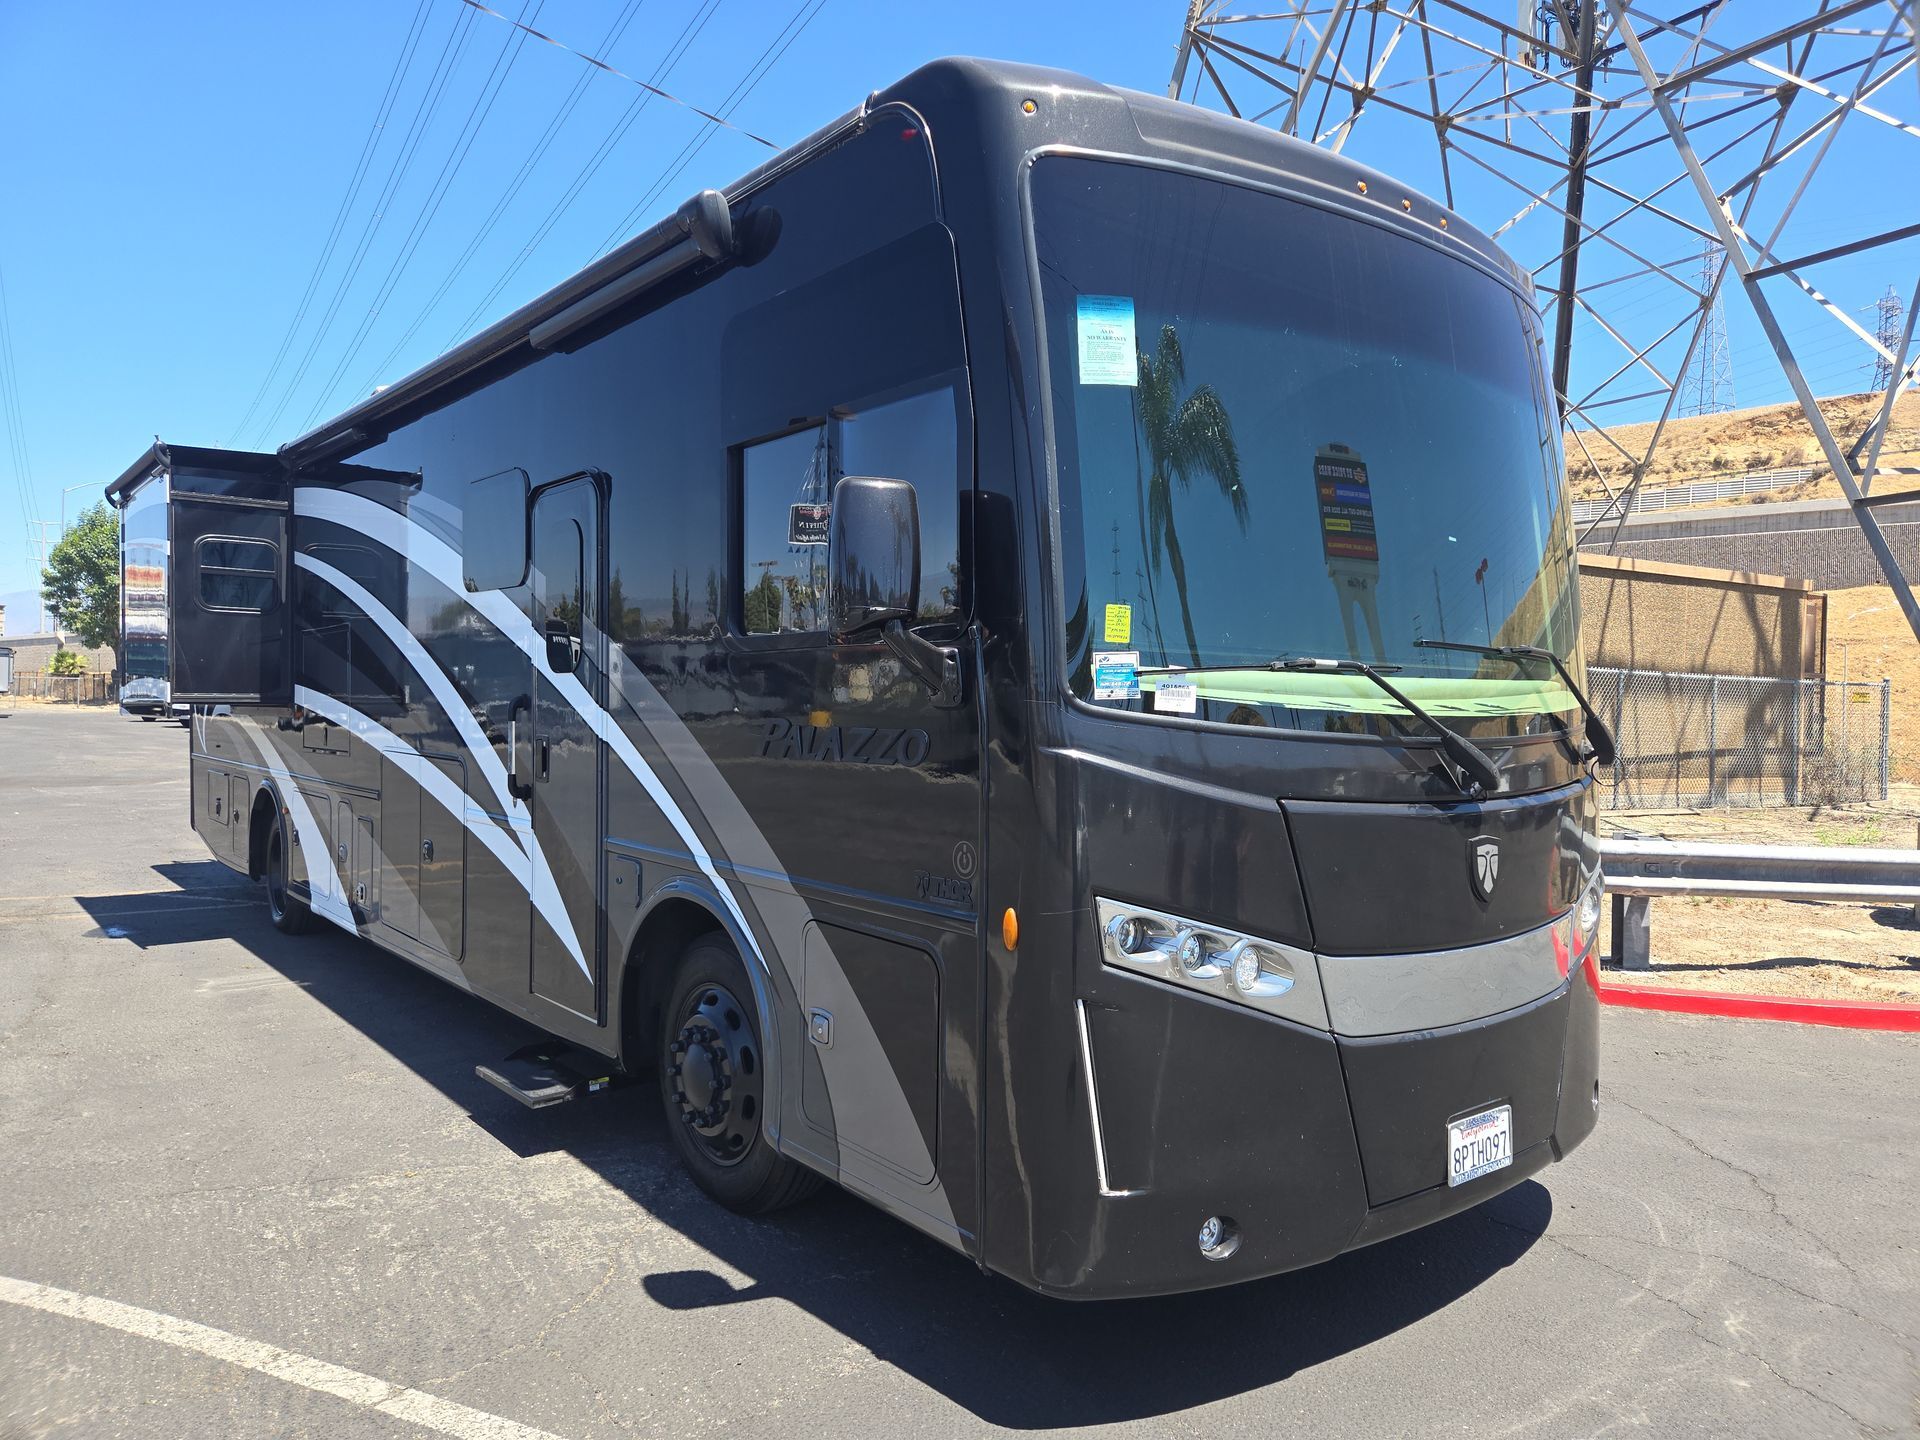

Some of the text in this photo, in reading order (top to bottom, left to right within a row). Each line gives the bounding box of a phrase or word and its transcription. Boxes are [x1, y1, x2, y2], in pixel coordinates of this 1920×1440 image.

[760, 718, 932, 768] PALAZZO
[931, 875, 974, 904] THOR
[1453, 1130, 1507, 1174] 8PIH097
